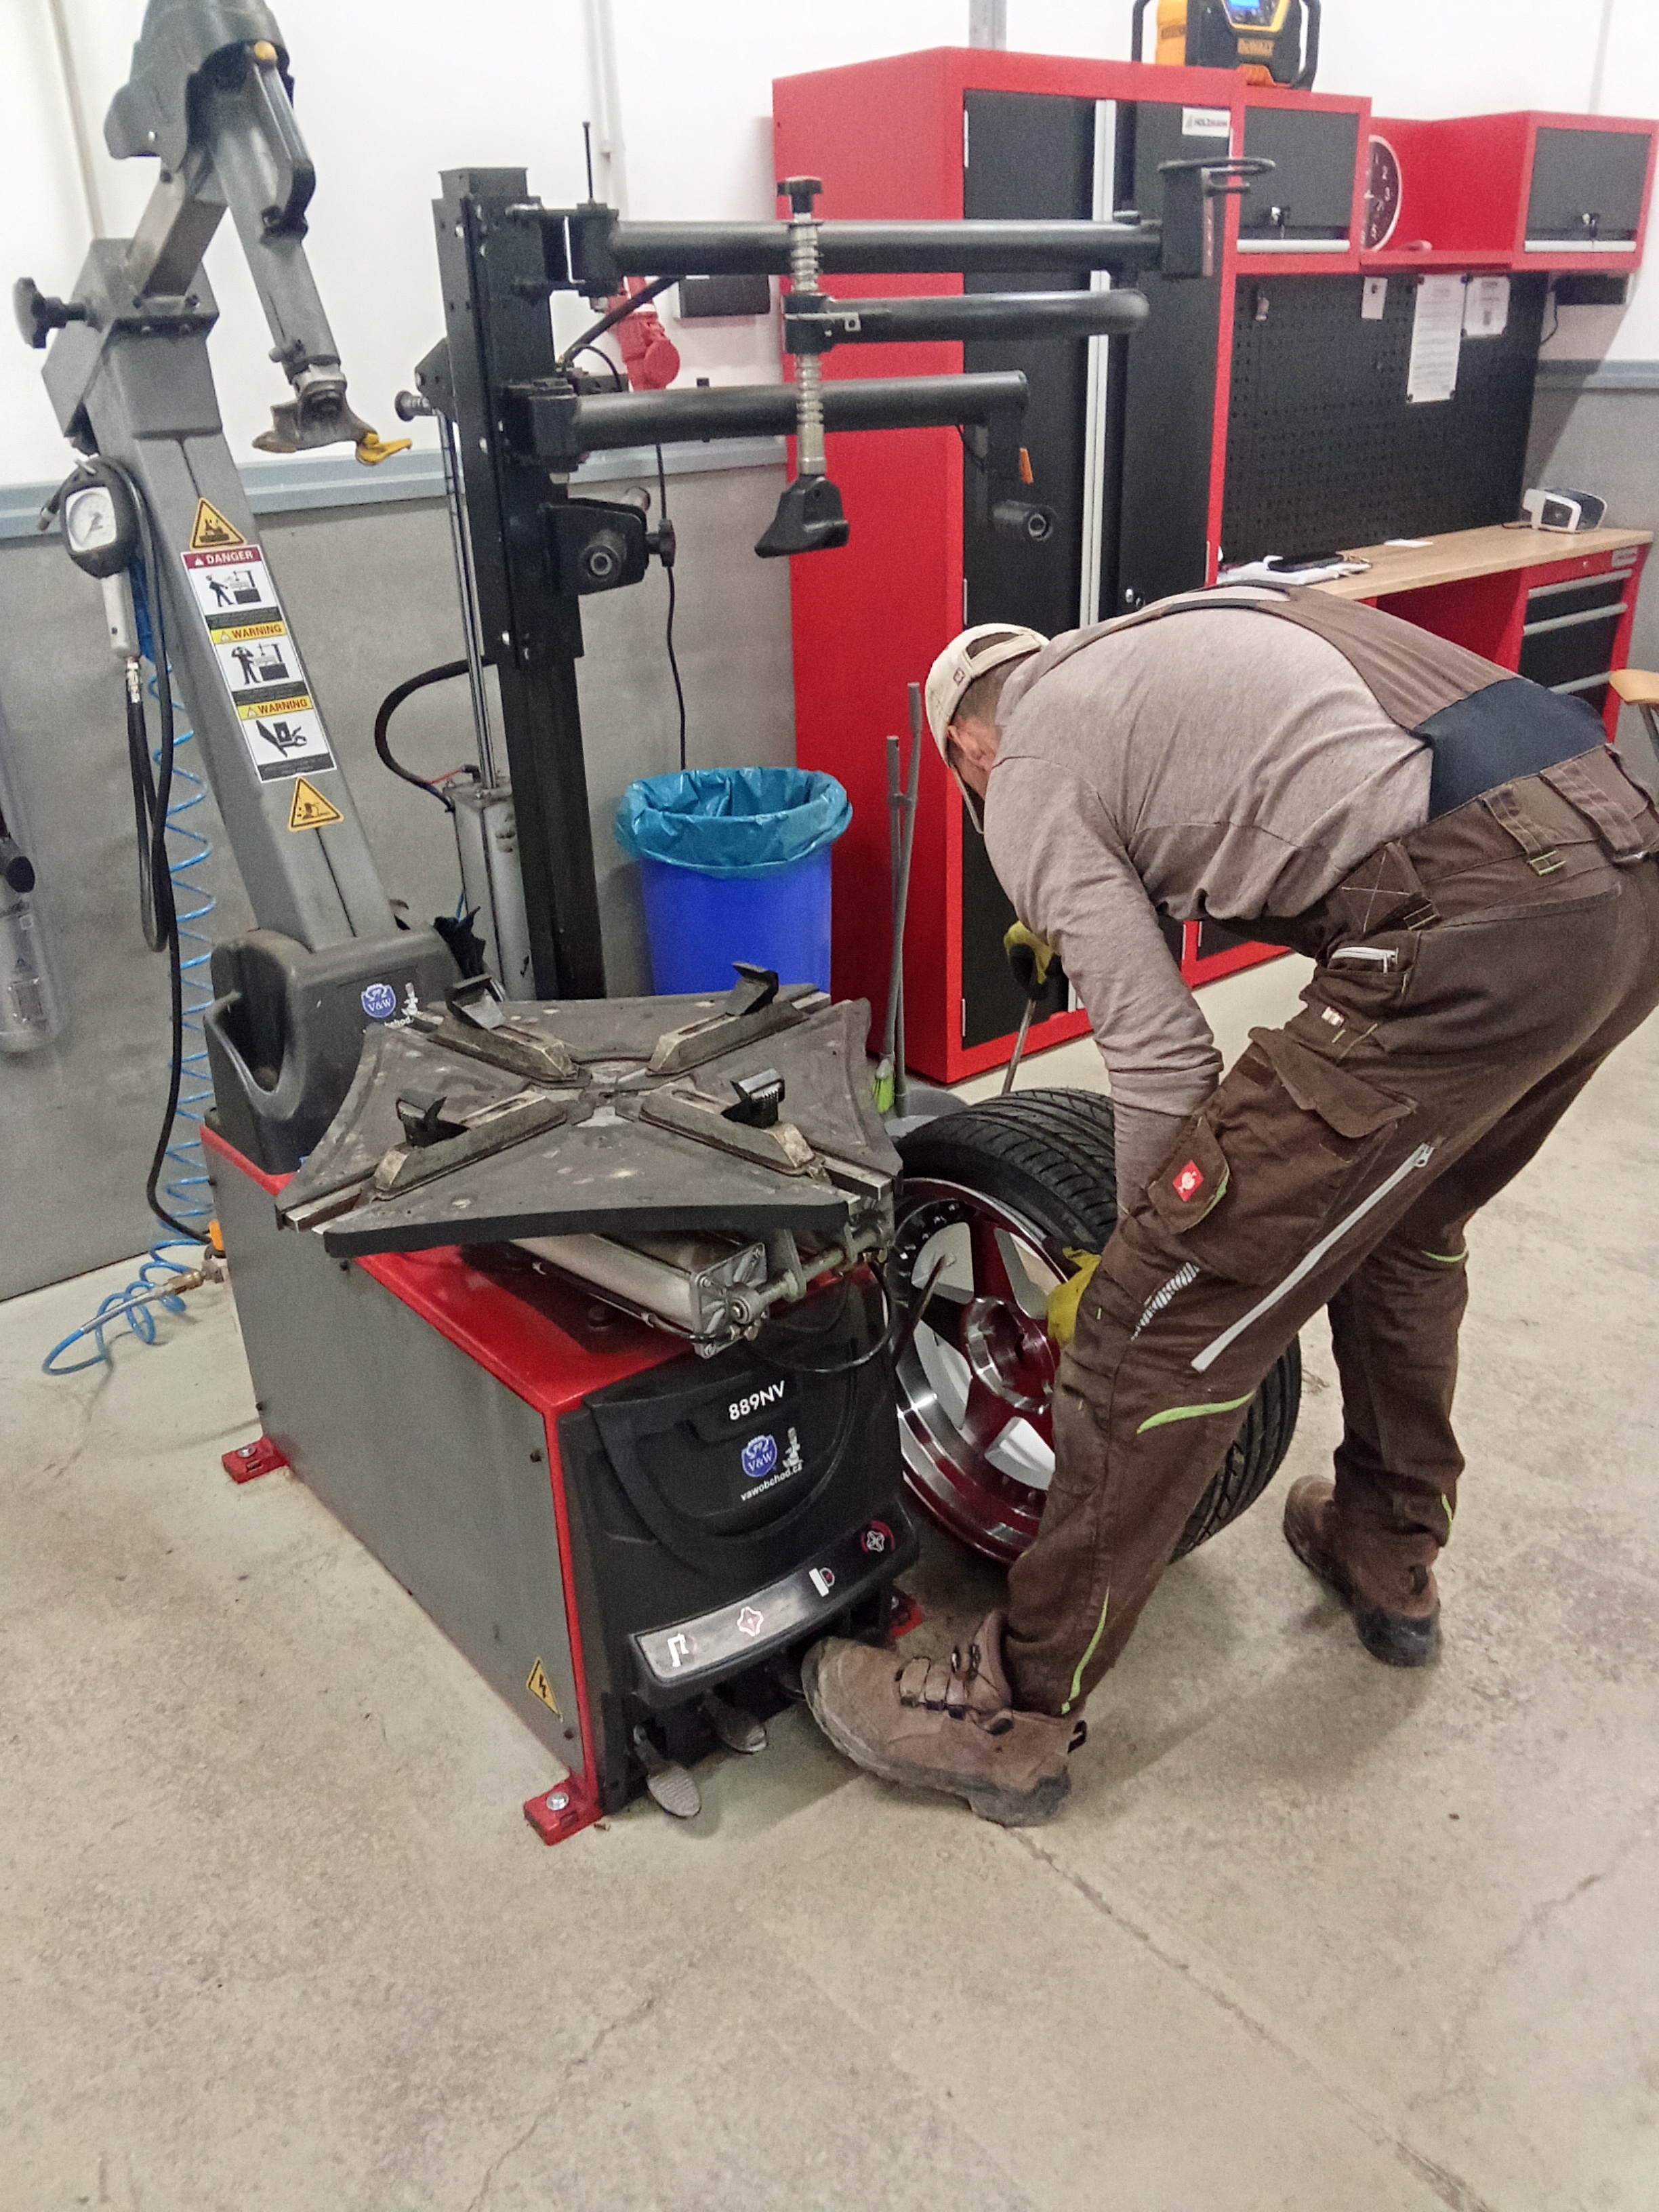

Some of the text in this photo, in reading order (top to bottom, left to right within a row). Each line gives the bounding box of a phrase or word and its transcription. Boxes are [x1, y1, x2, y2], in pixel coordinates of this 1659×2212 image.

[205, 550, 253, 565] DANGER
[231, 623, 282, 639] WARNING
[257, 698, 308, 714] WARNING
[368, 998, 391, 1012] V&W
[729, 1380, 785, 1420] 889NV
[747, 1451, 773, 1472] V&W
